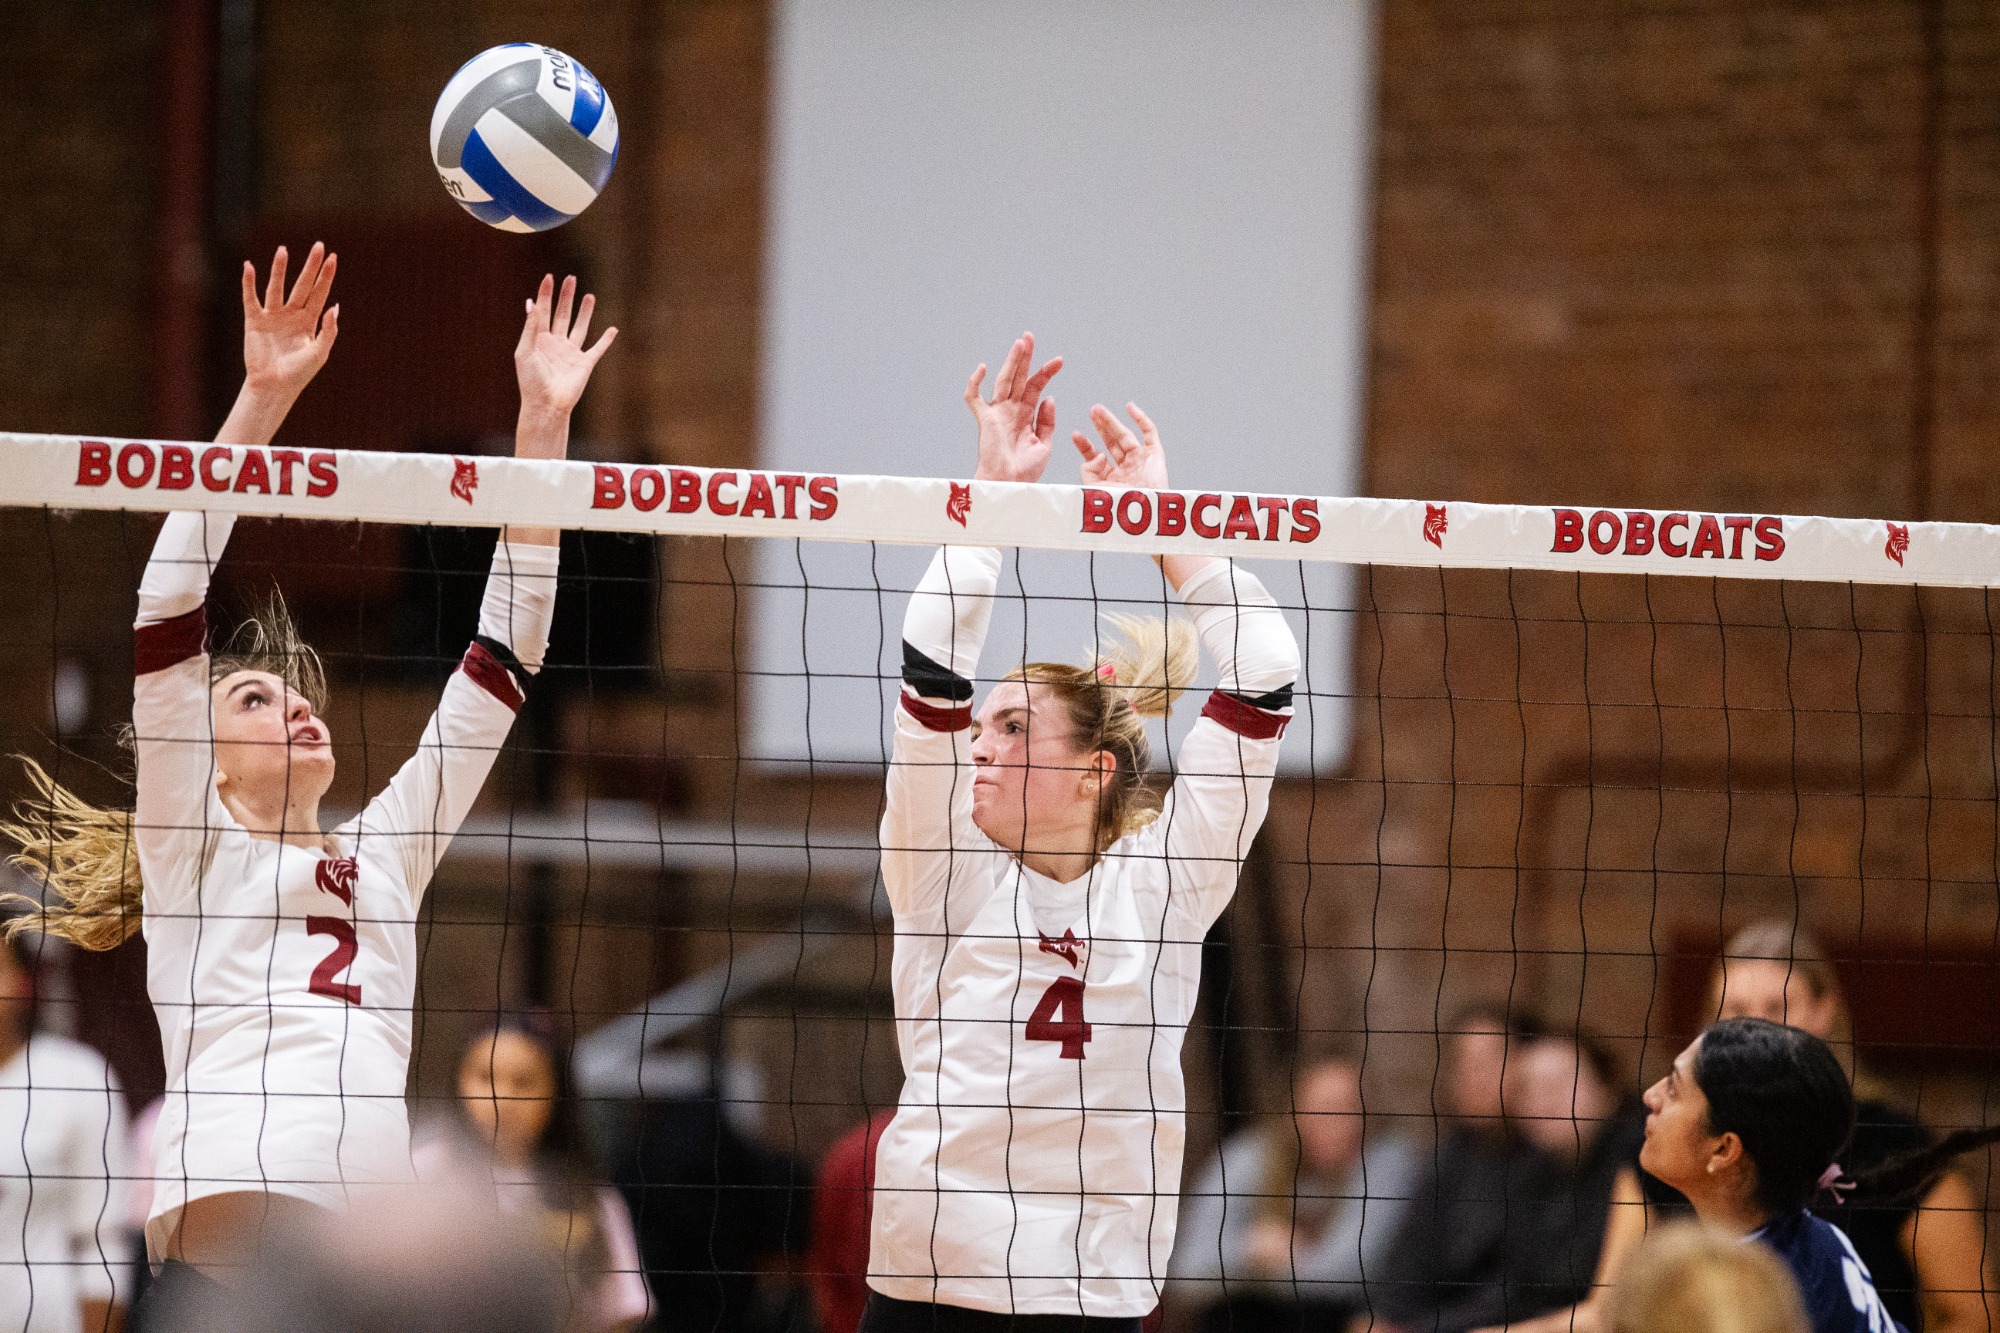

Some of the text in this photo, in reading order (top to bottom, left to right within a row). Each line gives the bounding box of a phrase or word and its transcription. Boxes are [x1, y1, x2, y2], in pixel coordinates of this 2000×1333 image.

[75, 441, 339, 498] BOBCATS
[591, 465, 839, 521] BOBCATS
[1080, 488, 1321, 544] BOBCATS
[1551, 508, 1786, 562] BOBCATS
[306, 915, 362, 1006] 2
[1025, 975, 1093, 1060] 4
